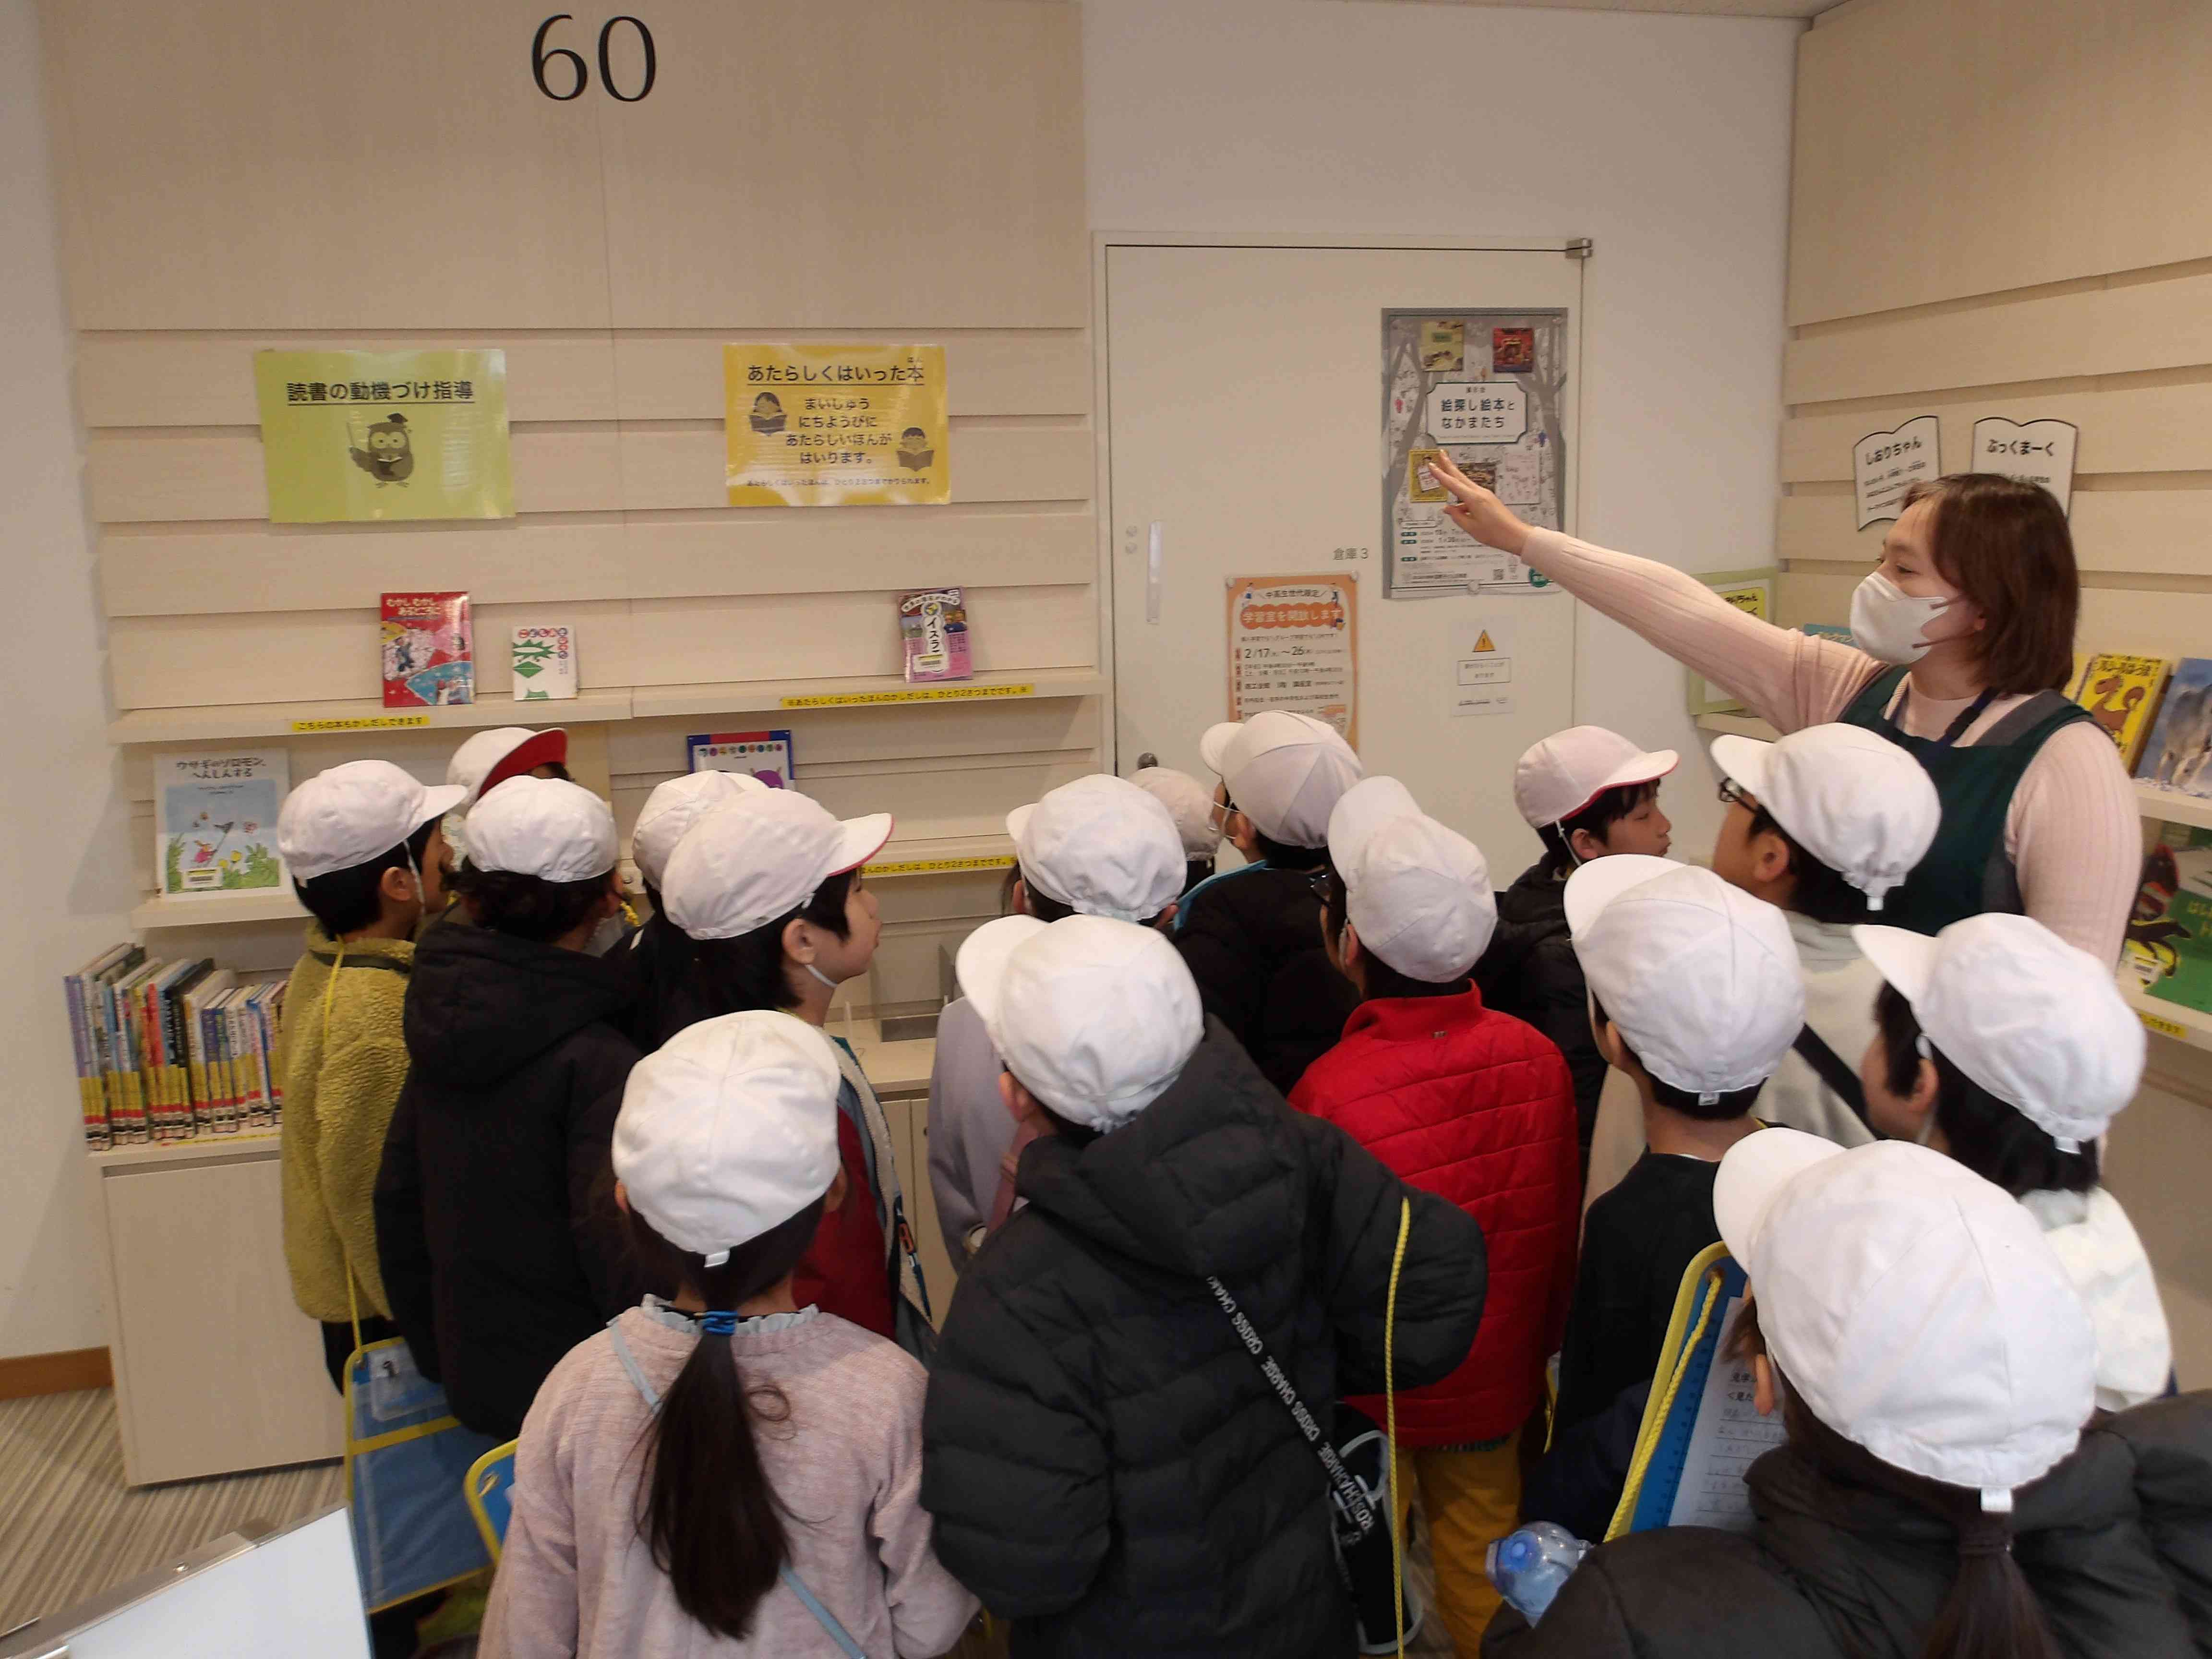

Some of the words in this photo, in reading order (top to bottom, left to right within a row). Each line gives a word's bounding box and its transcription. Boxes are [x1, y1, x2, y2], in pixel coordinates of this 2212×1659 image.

[532, 14, 656, 102] 60
[748, 363, 924, 382] あたらしくはいった本
[287, 381, 474, 401] 読書の動機づけ指導
[805, 397, 870, 410] まいしゅう
[1441, 398, 1515, 411] 絵探し絵本と
[799, 416, 878, 428] にちようびに
[1441, 417, 1505, 429] なかまたち
[786, 433, 892, 445] あたらしいほんが
[1864, 435, 1922, 466] しおりちゃん
[1986, 438, 2055, 457] ぶっくまーく
[801, 452, 873, 464] はいります。
